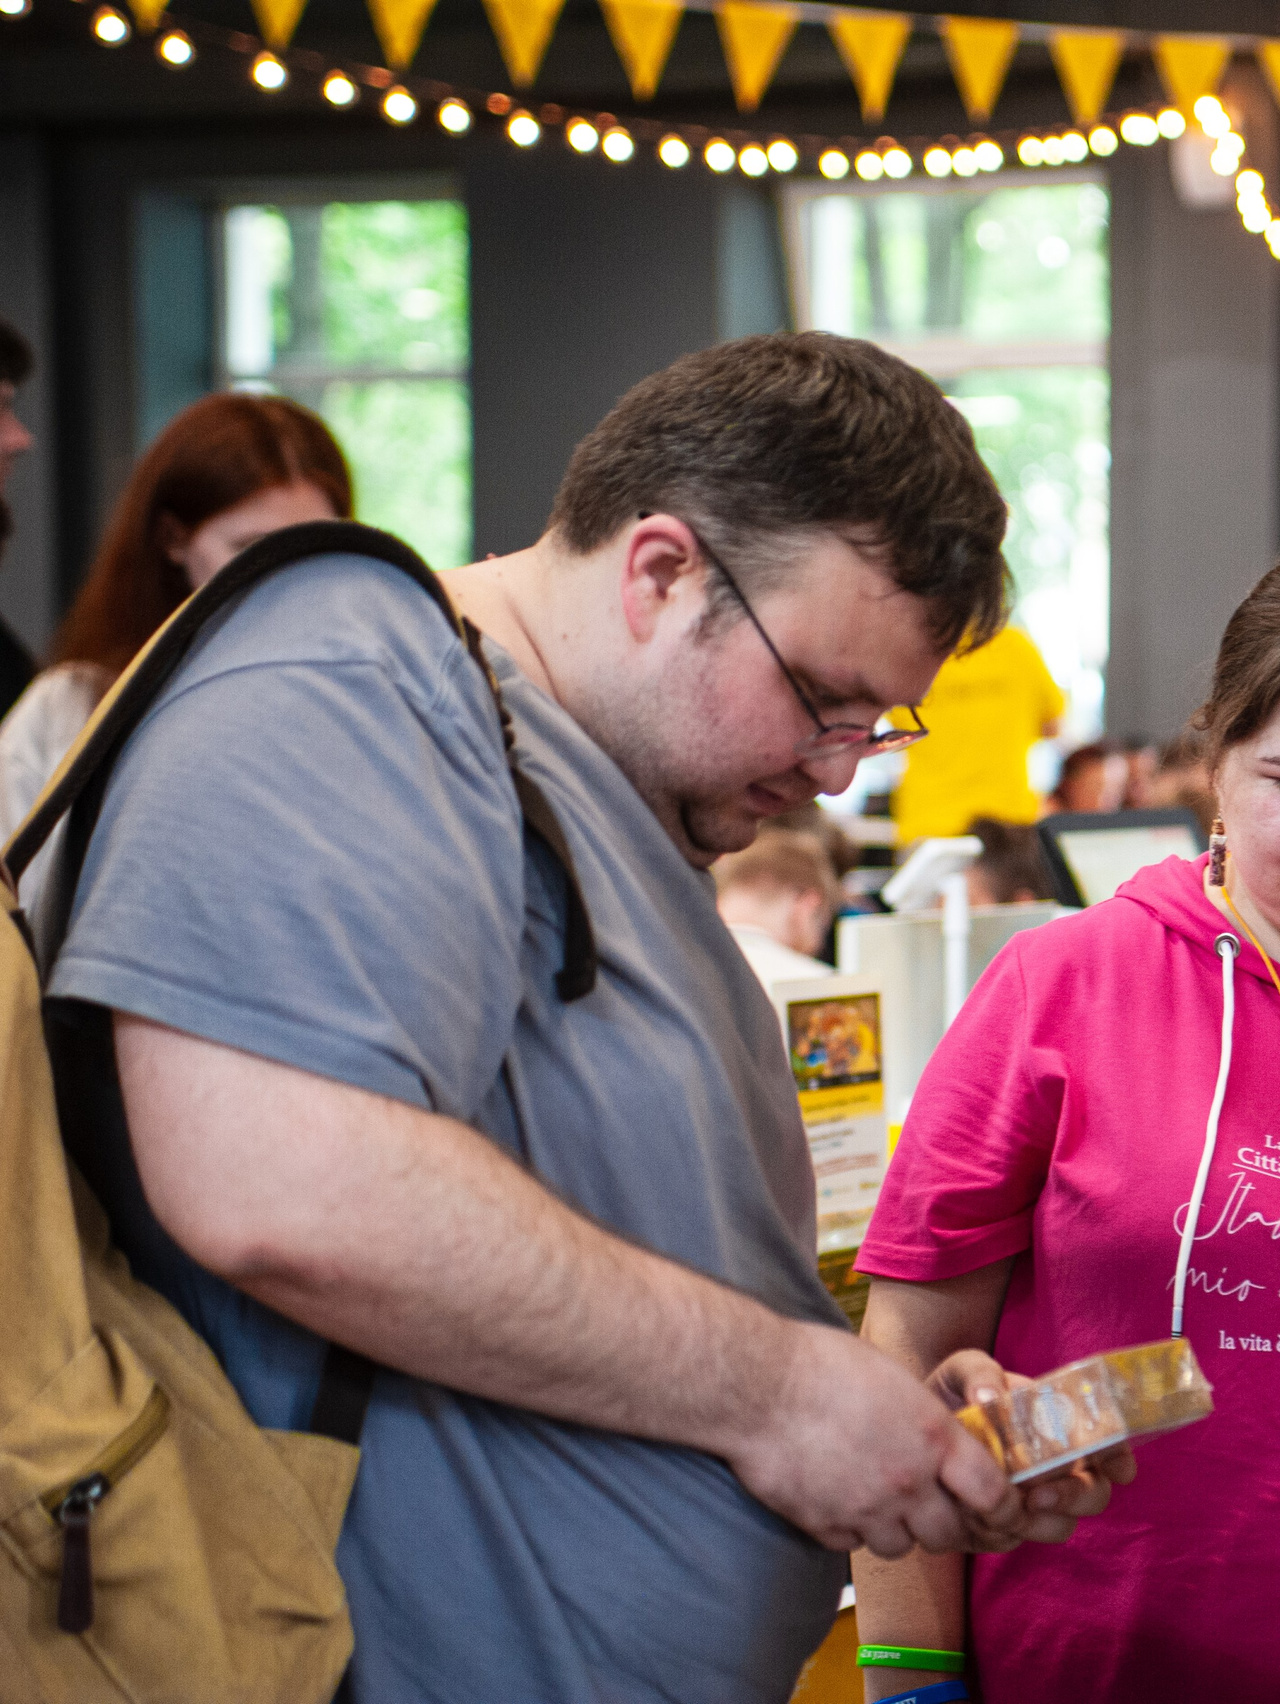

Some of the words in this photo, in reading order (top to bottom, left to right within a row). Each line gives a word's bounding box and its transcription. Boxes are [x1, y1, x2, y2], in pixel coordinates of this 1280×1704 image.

[1166, 1267, 1267, 1302] mio
[1219, 1330, 1236, 1350] la
[1239, 1332, 1272, 1352] vita
